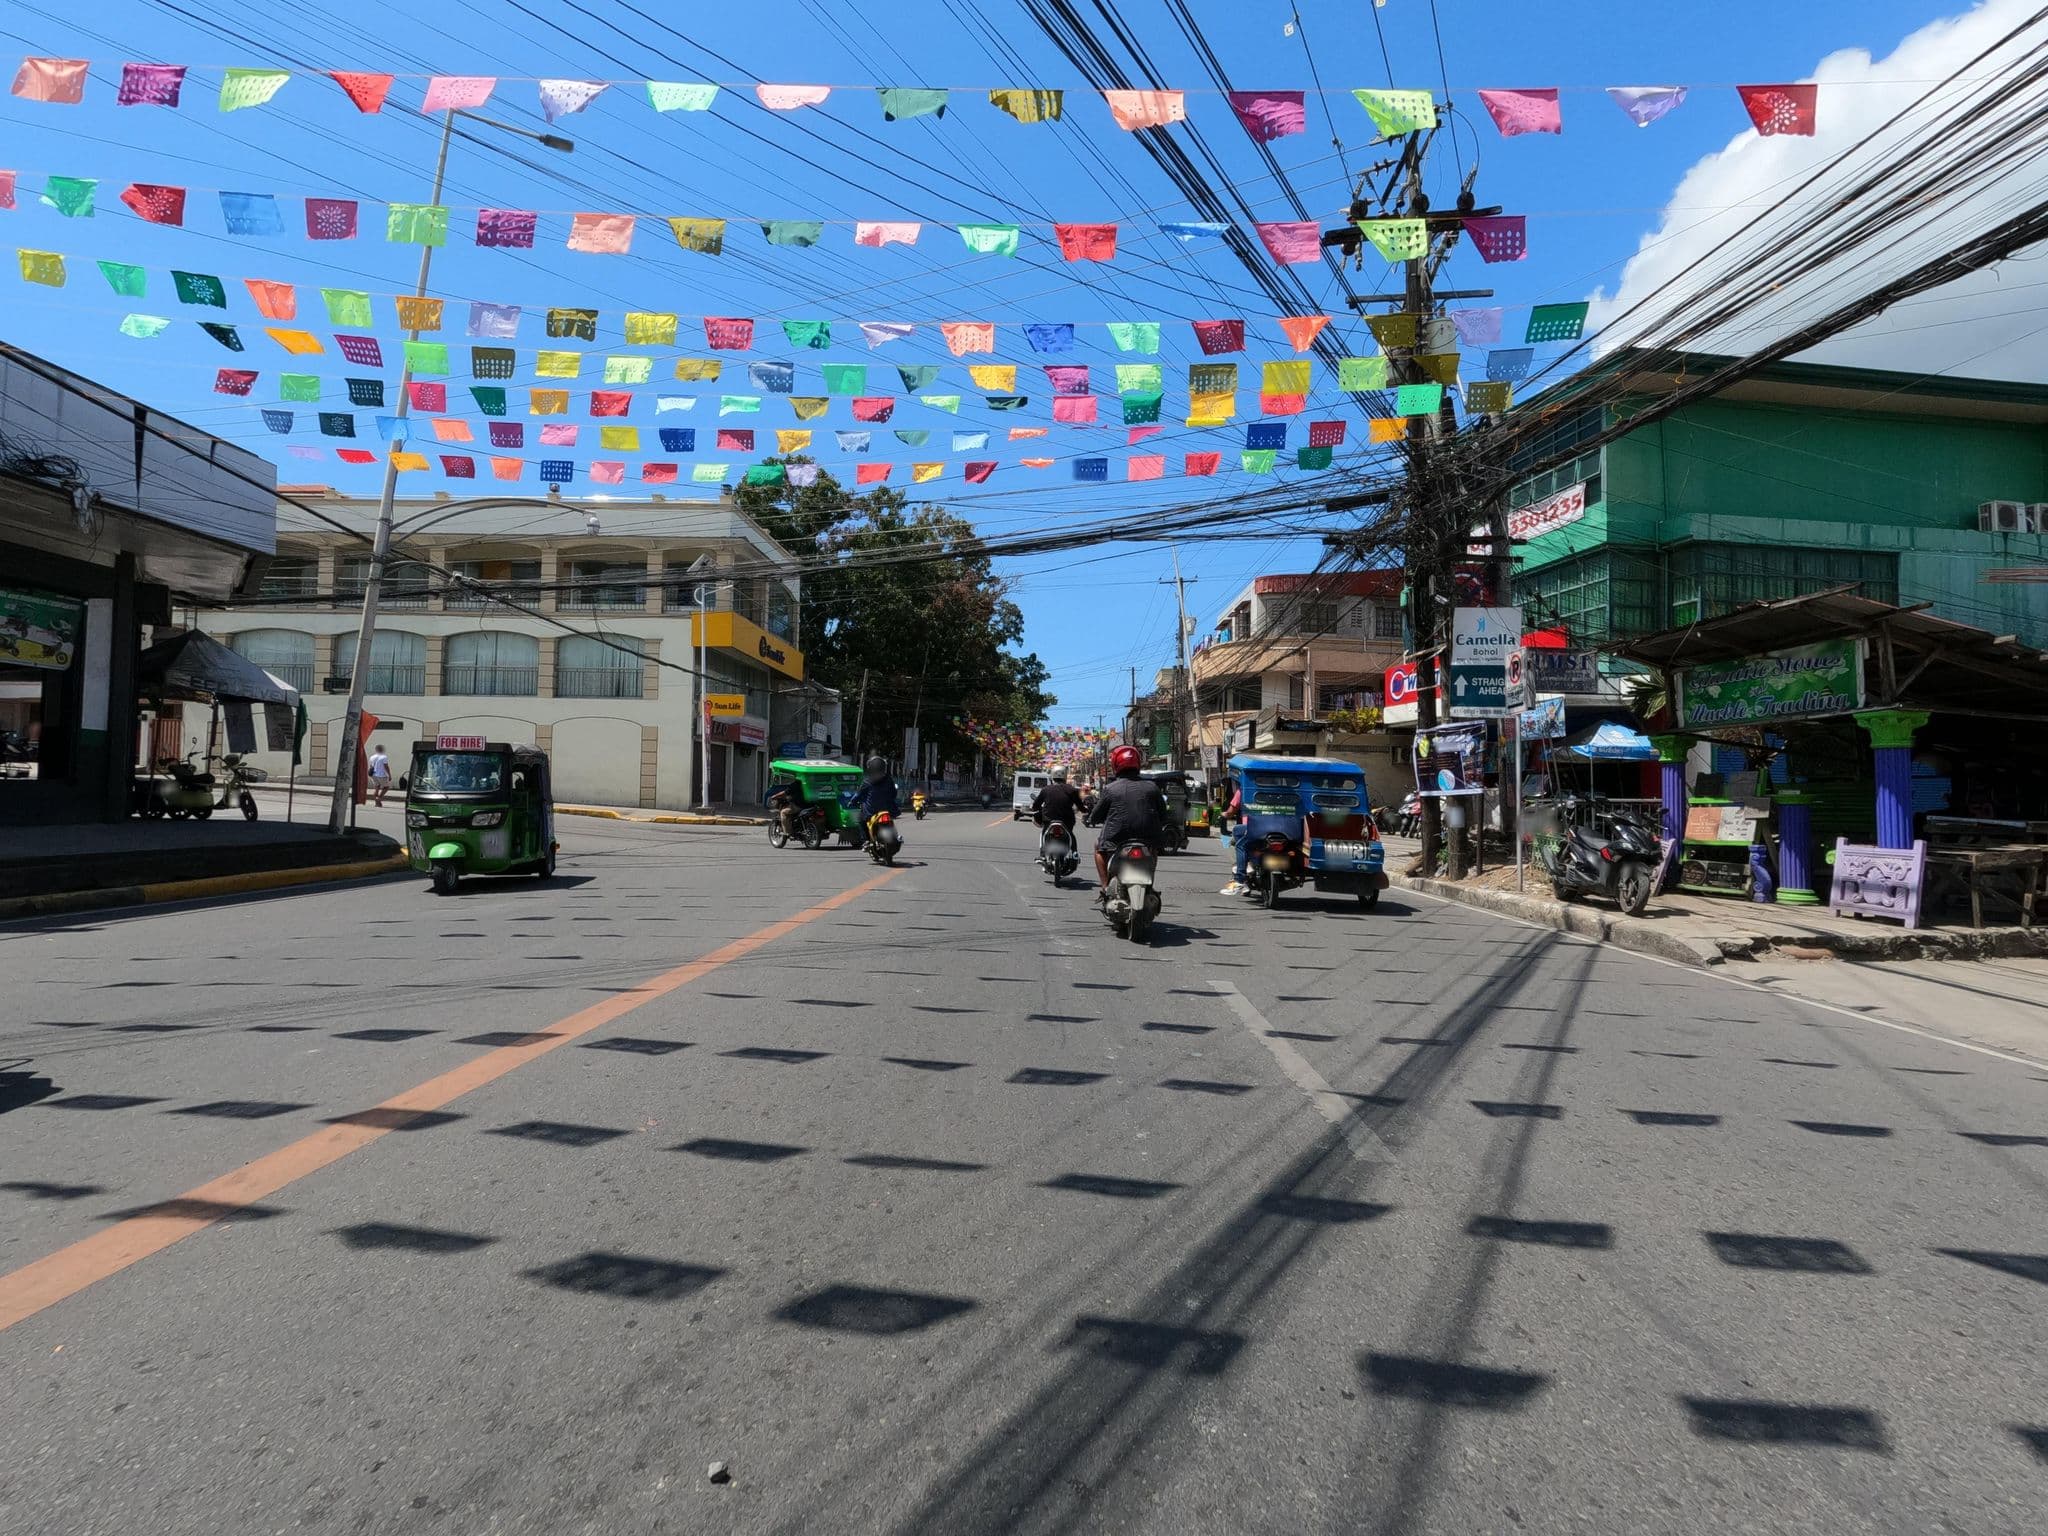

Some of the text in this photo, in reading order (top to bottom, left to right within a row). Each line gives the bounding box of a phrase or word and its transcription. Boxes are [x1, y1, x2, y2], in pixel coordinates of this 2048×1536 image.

[1455, 634, 1516, 645] Camella
[1773, 657, 1844, 674] Stones
[1471, 677, 1505, 686] STRAIG
[728, 702, 741, 710] Life
[1757, 691, 1850, 715] Trading
[440, 737, 482, 748] FOR HIRE
